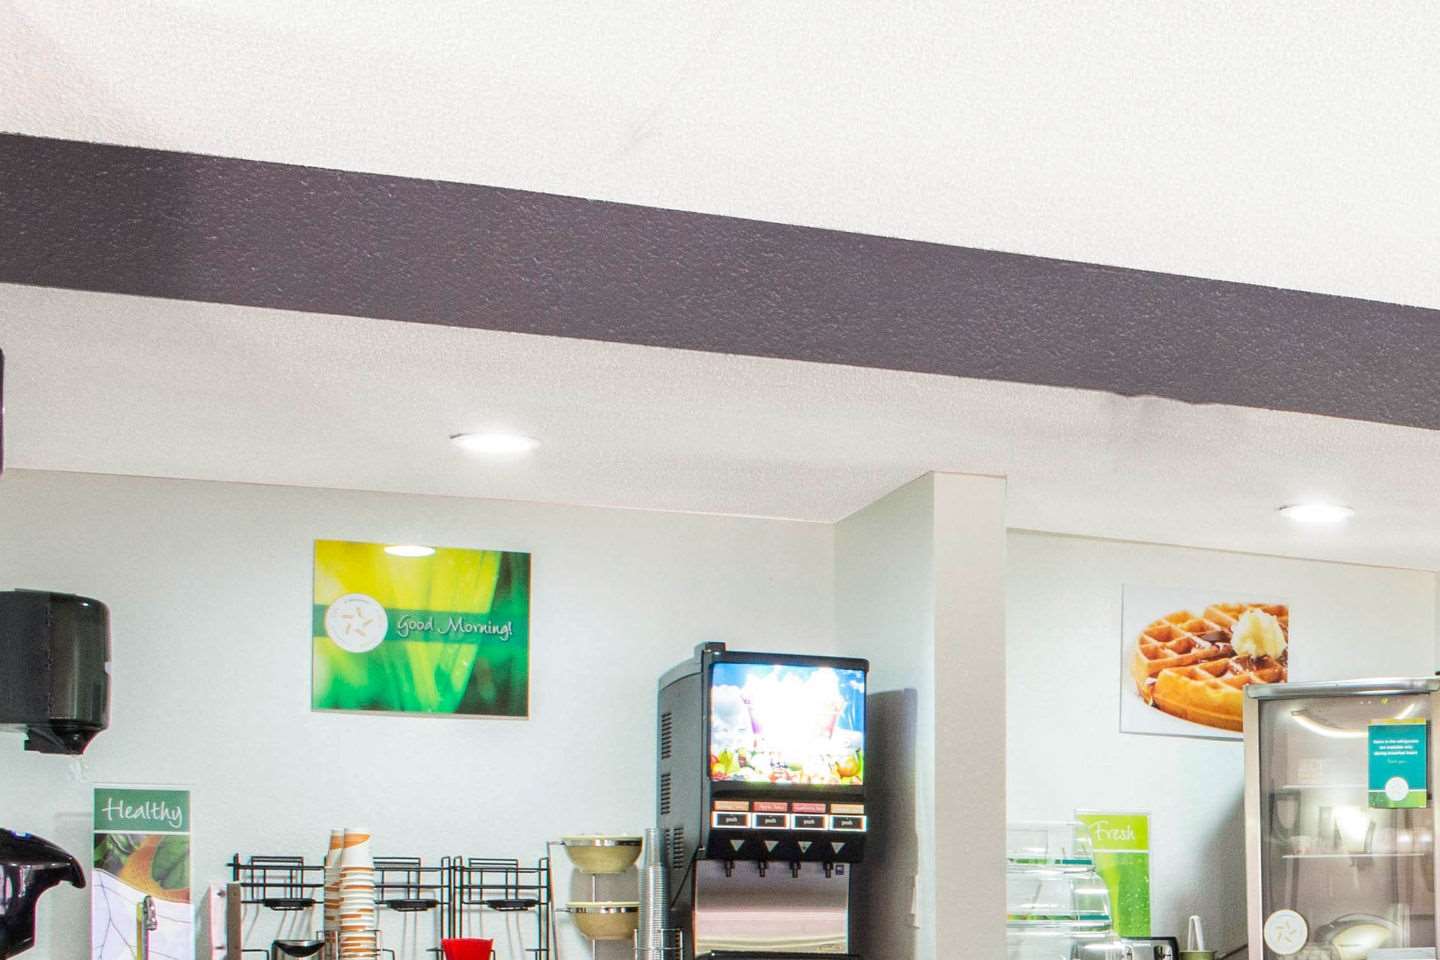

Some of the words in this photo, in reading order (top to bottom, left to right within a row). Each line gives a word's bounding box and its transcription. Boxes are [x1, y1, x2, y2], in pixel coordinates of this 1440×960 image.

[398, 614, 433, 638] Good
[439, 616, 513, 641] Morning!
[101, 797, 183, 829] Healthy
[1089, 820, 1136, 841] Fresh
